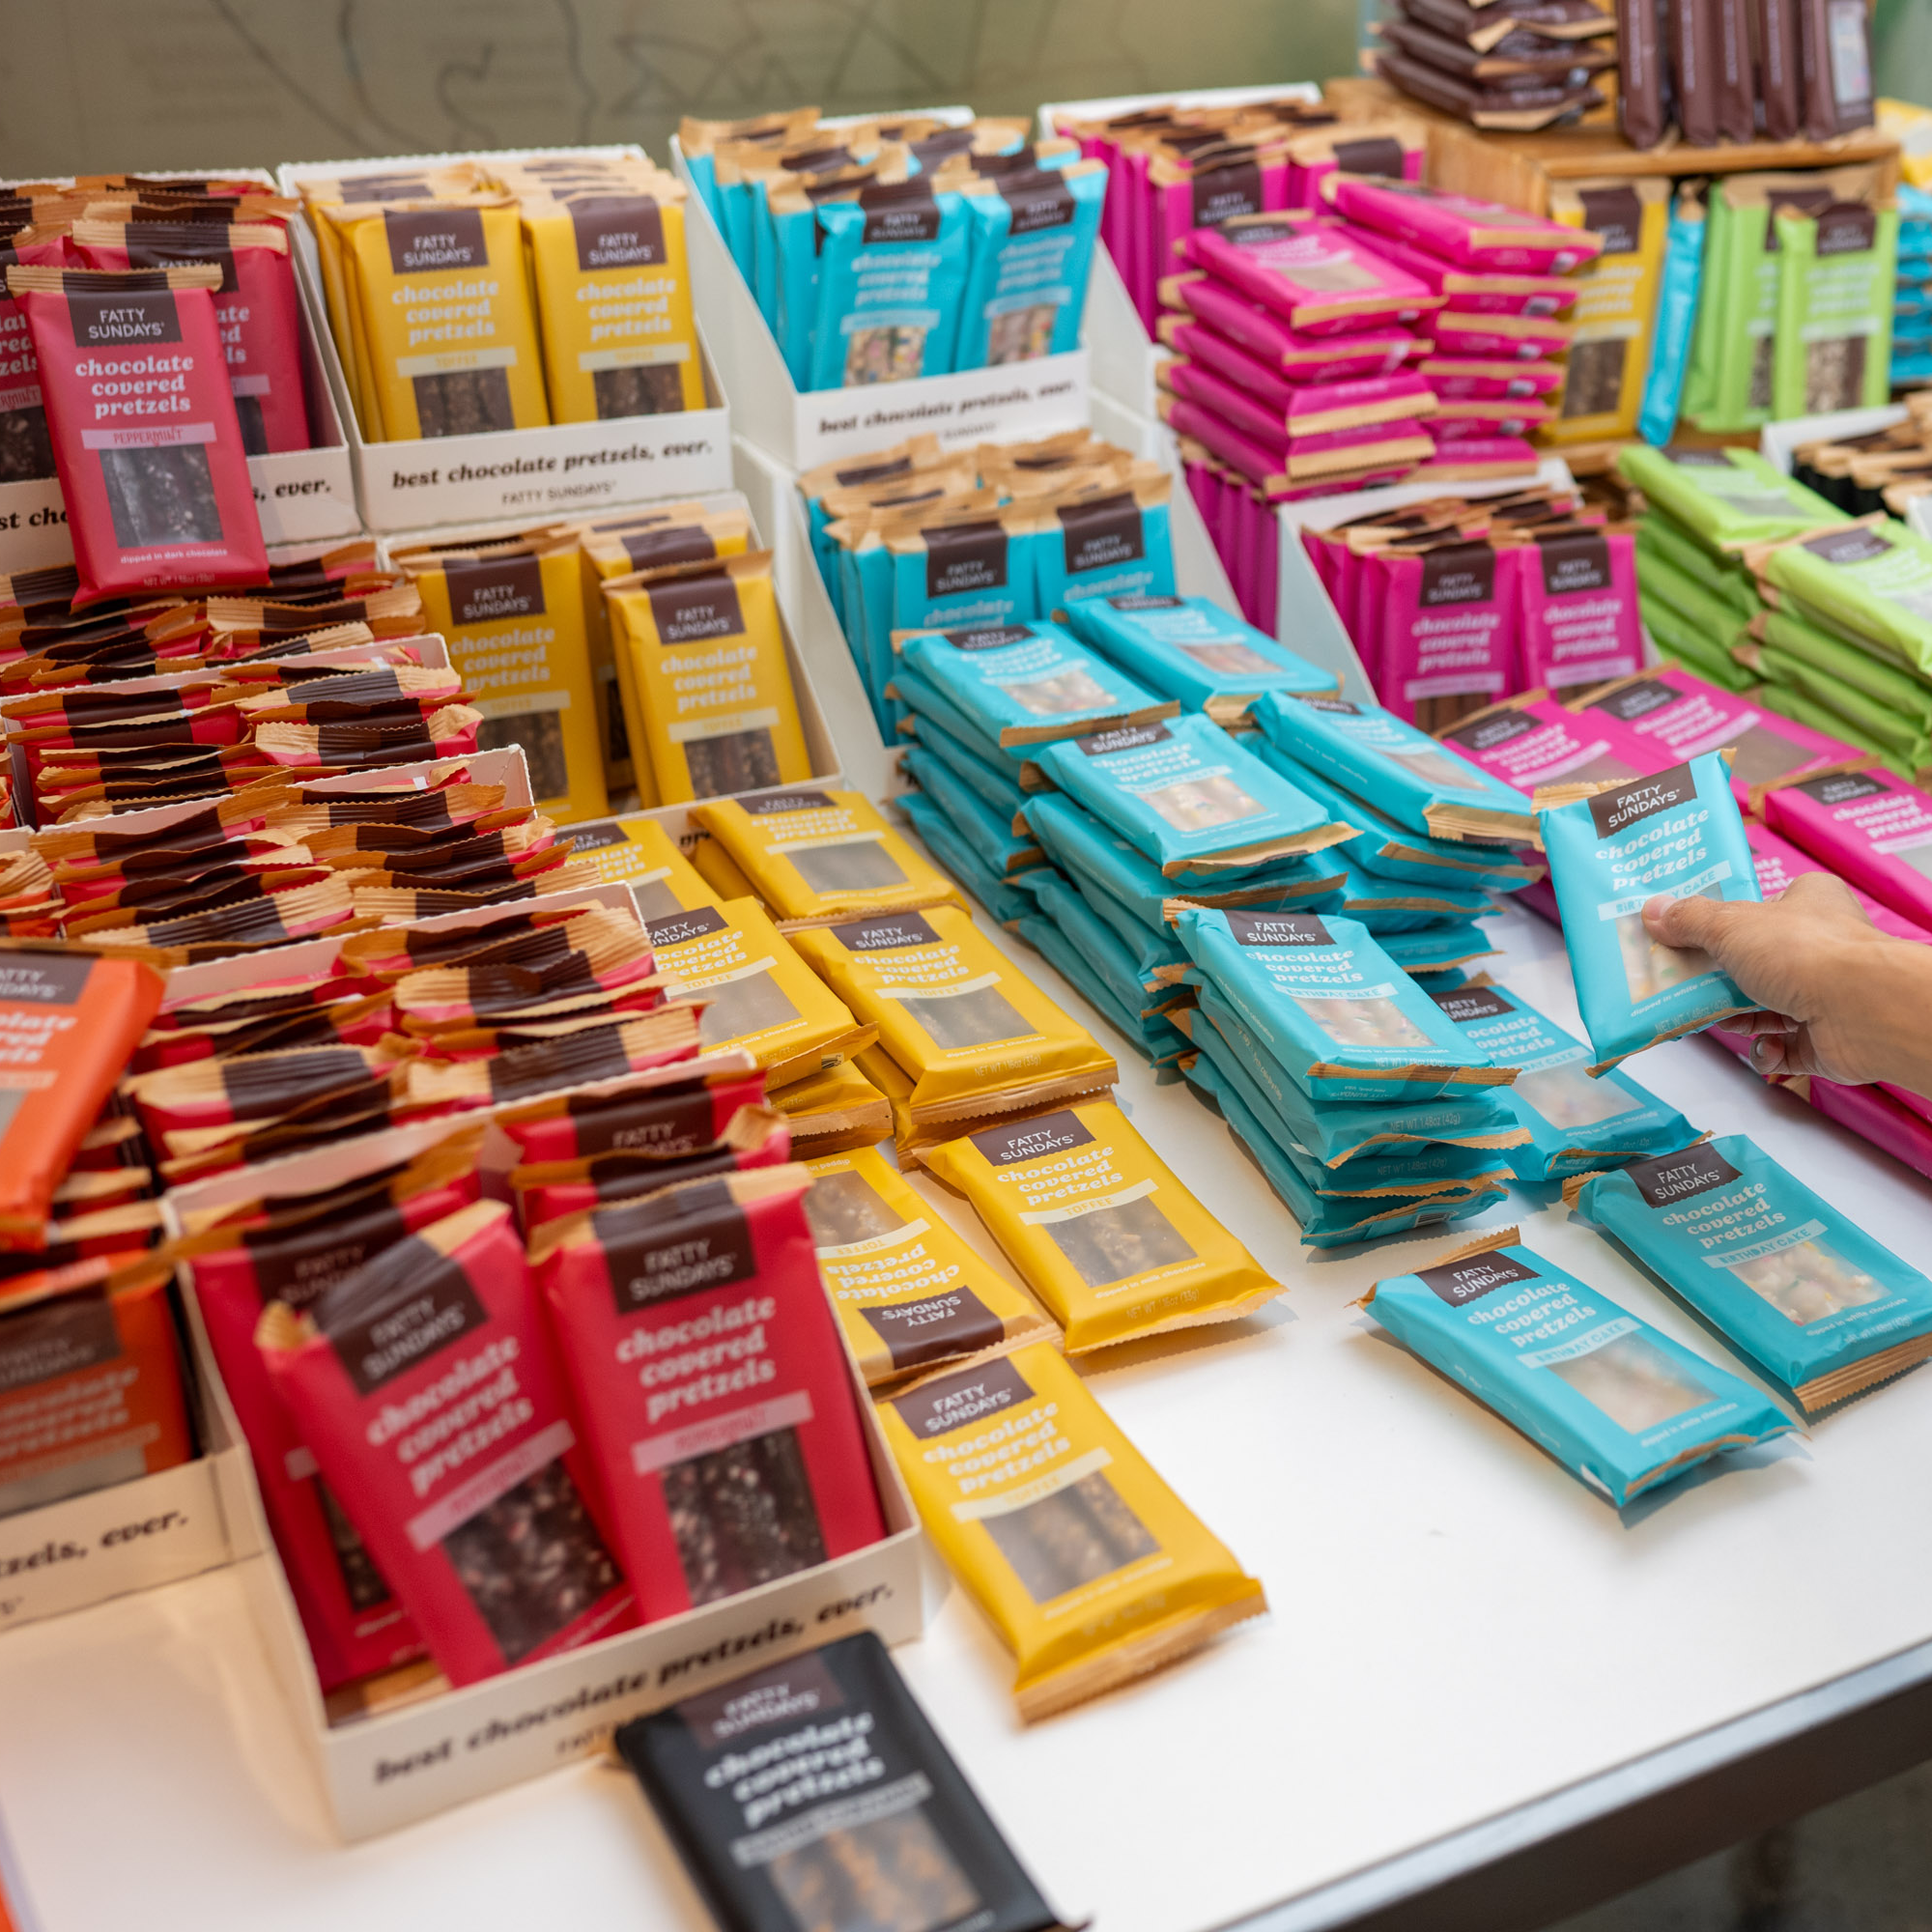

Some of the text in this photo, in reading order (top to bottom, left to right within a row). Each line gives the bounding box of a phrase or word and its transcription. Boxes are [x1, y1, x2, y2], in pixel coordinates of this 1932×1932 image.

[413, 234, 457, 249] FATTY
[599, 233, 639, 248] FATTY
[403, 247, 473, 268] SUNDAYS
[392, 280, 499, 304] chocolate
[576, 277, 677, 302] chocolate
[99, 308, 145, 324] FATTY
[406, 300, 491, 324] covered
[589, 297, 668, 320] covered
[88, 322, 163, 339] SUNDAYS
[410, 320, 496, 348] pretzels
[590, 316, 671, 343] pretzels
[75, 355, 194, 377] chocolate
[92, 374, 186, 397] covered
[95, 395, 191, 420] pretzels
[113, 428, 184, 445] PEPPERMINT
[392, 440, 713, 490] best chocolate pretzels, ever.
[275, 478, 331, 498] ever.
[502, 481, 615, 506] FATTY SUNDAYS
[473, 584, 515, 601] FATTY
[463, 598, 530, 618] SUNDAYS
[675, 605, 715, 622] FATTY
[450, 627, 555, 656] chocolate
[667, 619, 730, 639] SUNDAYS
[464, 645, 547, 673] covered
[661, 645, 757, 674] chocolate
[466, 664, 551, 693] pretzels
[674, 664, 753, 691] covered
[677, 684, 756, 714] pretzels
[1617, 784, 1662, 809] FATTY
[1608, 791, 1680, 828] SUNDAYS
[1595, 810, 1709, 860] chocolate
[1610, 827, 1702, 873] covered
[1612, 847, 1708, 892] pretzels
[1684, 870, 1717, 895] CAKE
[861, 927, 903, 940] FATTY
[1246, 932, 1316, 943] SUNDAYS
[1254, 922, 1295, 932] FATTY
[855, 933, 923, 950] SUNDAYS
[854, 945, 961, 966] chocolate
[874, 955, 960, 974] covered
[1245, 950, 1354, 963] chocolate
[1265, 959, 1353, 974] covered
[684, 974, 733, 989] TOFFEE
[881, 965, 970, 984] pretzels
[1273, 972, 1364, 983] pretzels
[917, 986, 960, 997] TOFFEE
[1631, 984, 1698, 1017] dipped in white
[1446, 1004, 1498, 1019] UNDAYS
[742, 1021, 809, 1045] milk chocolate
[1466, 1015, 1540, 1039] ocolate
[1488, 1037, 1556, 1060] retzels
[1390, 1121, 1405, 1131] NET
[1406, 1120, 1418, 1130] WT
[1442, 1113, 1461, 1125] (42g)
[1001, 1134, 1074, 1160] SUNDAYS
[1007, 1129, 1053, 1150] FATTY
[819, 1158, 851, 1170] dipped
[997, 1146, 1114, 1182] chocolate
[1017, 1160, 1112, 1193] covered
[1657, 1163, 1698, 1184] FATTY
[1026, 1173, 1123, 1207] pretzels
[1654, 1170, 1720, 1200] SUNDAYS
[1063, 1197, 1115, 1217] TOFFEE
[1662, 1182, 1767, 1226] chocolate
[1687, 1197, 1772, 1236] covered
[1698, 1212, 1786, 1250] pretzels
[1777, 1228, 1812, 1248] CAKE
[644, 1238, 711, 1274] FATTY
[826, 1243, 927, 1276] pretzels
[838, 1239, 888, 1255] TOFFEE
[837, 1264, 960, 1300] chocolate
[838, 1259, 936, 1289] covered
[1094, 1285, 1128, 1299] dipped
[1140, 1274, 1161, 1285] milk
[1162, 1262, 1207, 1278] chocolate
[1453, 1265, 1495, 1282] FATTY
[1453, 1269, 1520, 1298] SUNDAYS
[881, 1295, 962, 1321] SUNDAYS
[1467, 1283, 1571, 1325] chocolate
[1494, 1293, 1578, 1334] covered
[370, 1296, 434, 1347] FATTY
[616, 1296, 777, 1363] chocolate
[906, 1310, 956, 1327] FATTY
[1510, 1305, 1597, 1349] pretzels
[639, 1323, 768, 1388] covered
[366, 1335, 521, 1445] chocolate
[646, 1358, 777, 1424] pretzels
[932, 1382, 987, 1413] FATTY
[398, 1364, 520, 1463] covered
[924, 1389, 1012, 1433] SUNDAYS
[923, 1402, 1060, 1463] chocolate
[409, 1398, 534, 1496] pretzels
[948, 1420, 1058, 1476] covered
[957, 1436, 1070, 1494] pretzels
[100, 1509, 189, 1547] ever.
[374, 1740, 452, 1784] best
[467, 1671, 647, 1752] chocolate
[656, 1613, 806, 1688] pretzels,
[815, 1582, 895, 1625] ever.
